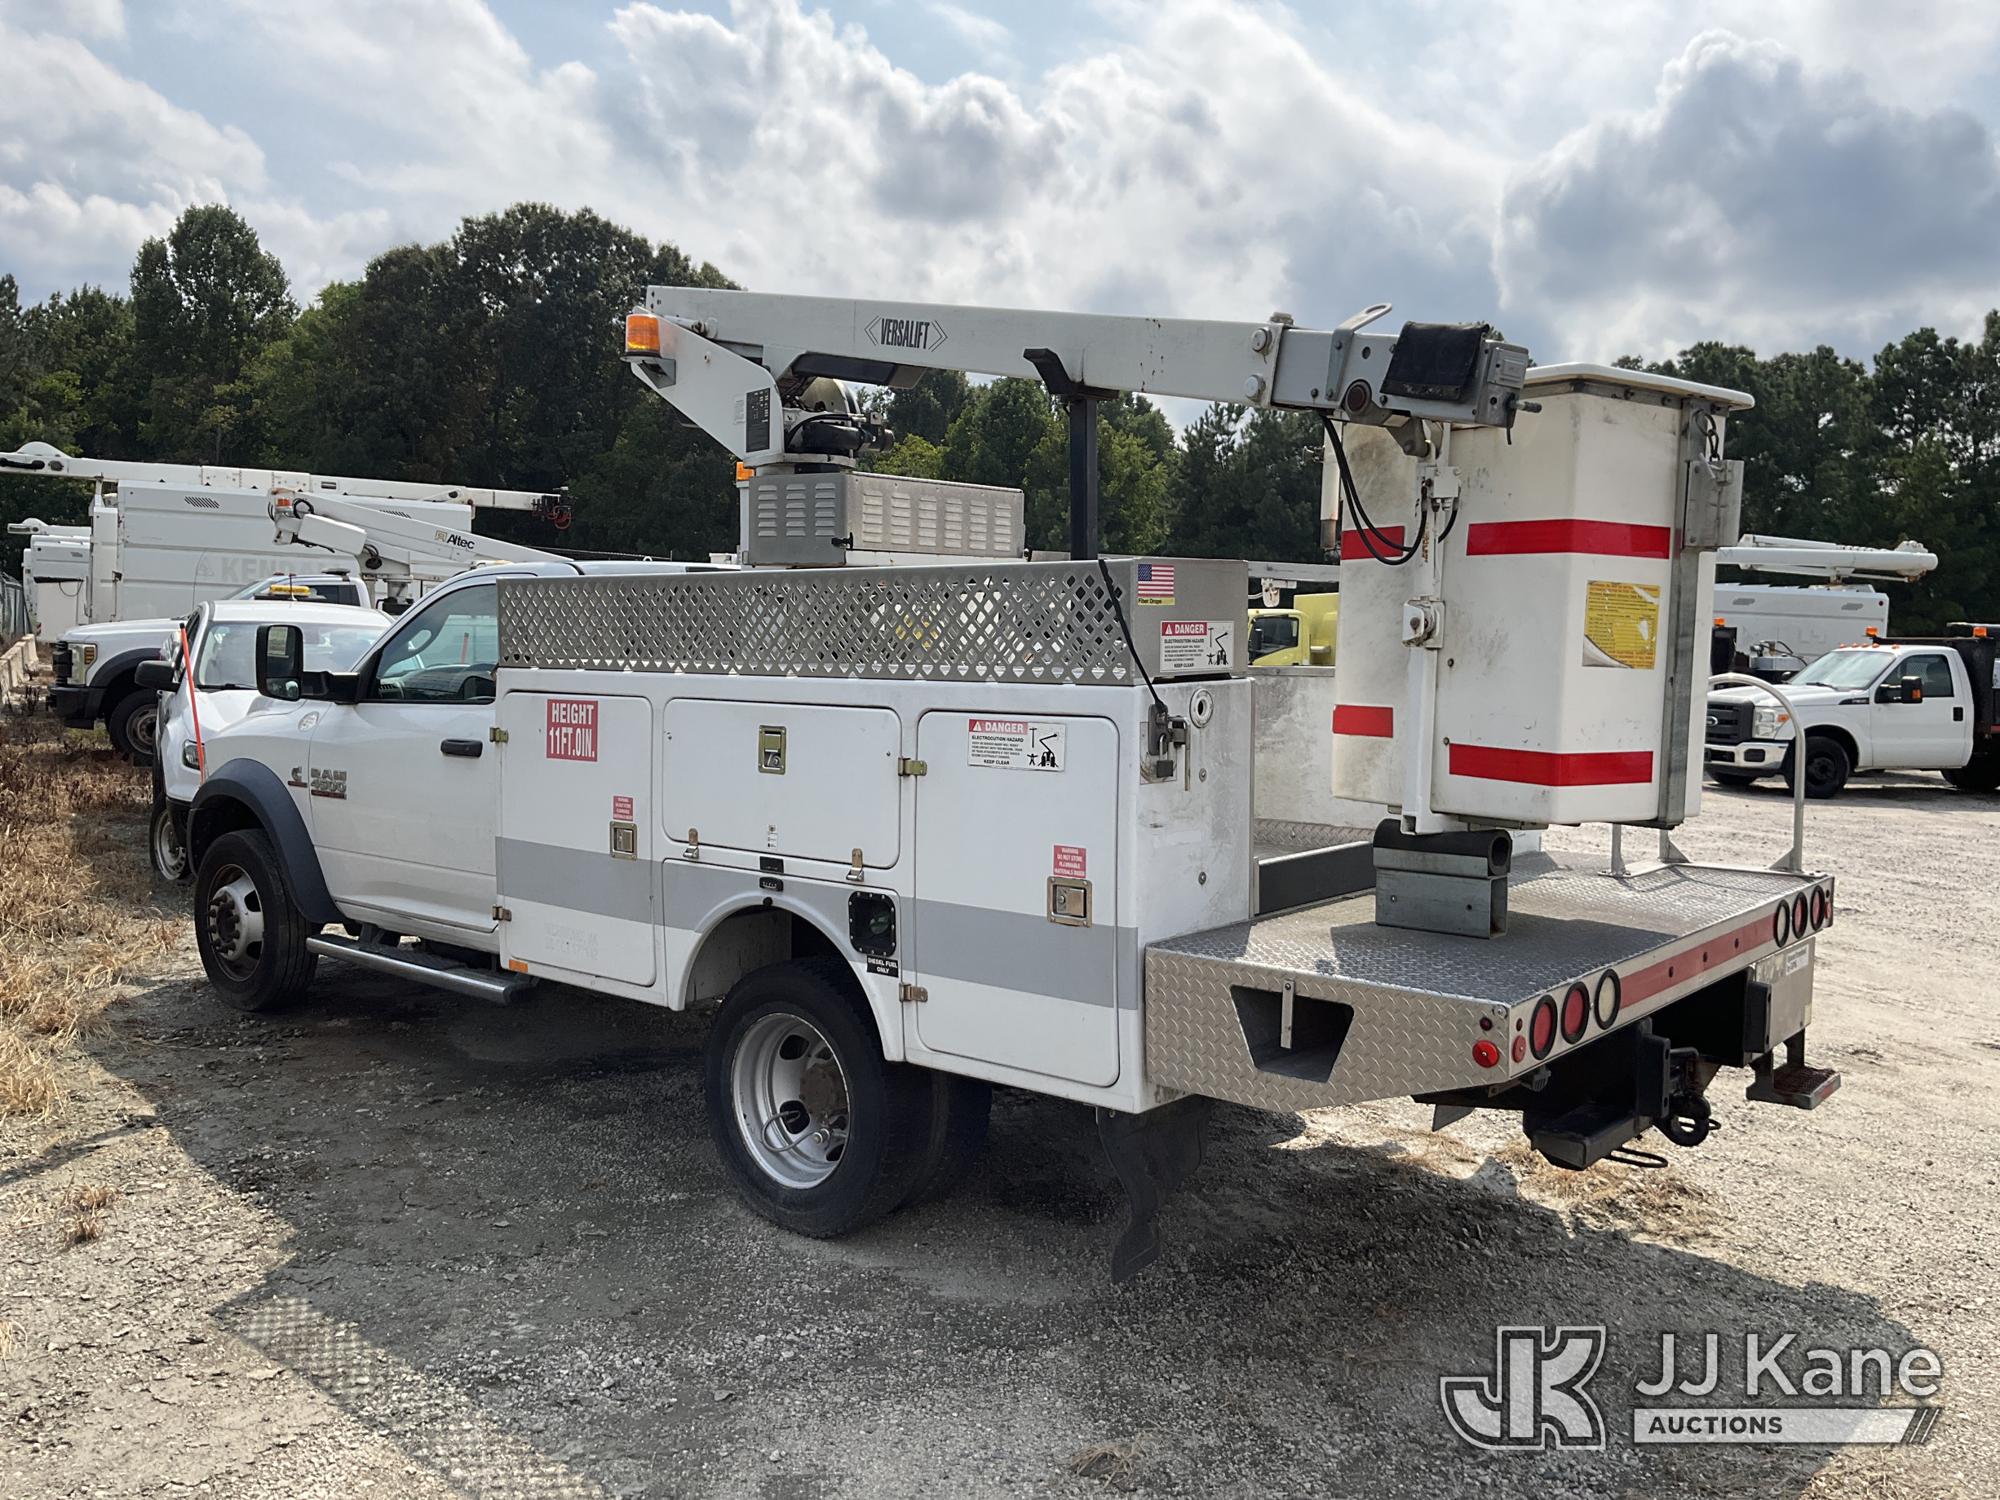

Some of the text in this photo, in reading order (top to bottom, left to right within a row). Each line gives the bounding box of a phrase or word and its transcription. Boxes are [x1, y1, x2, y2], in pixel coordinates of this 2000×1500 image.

[881, 318, 930, 349] VERSALIFT
[446, 534, 475, 550] Altec
[1175, 624, 1204, 634] DANGER
[552, 702, 594, 725] HEIGHT
[985, 722, 1023, 733] DANGER
[310, 767, 347, 781] RAM
